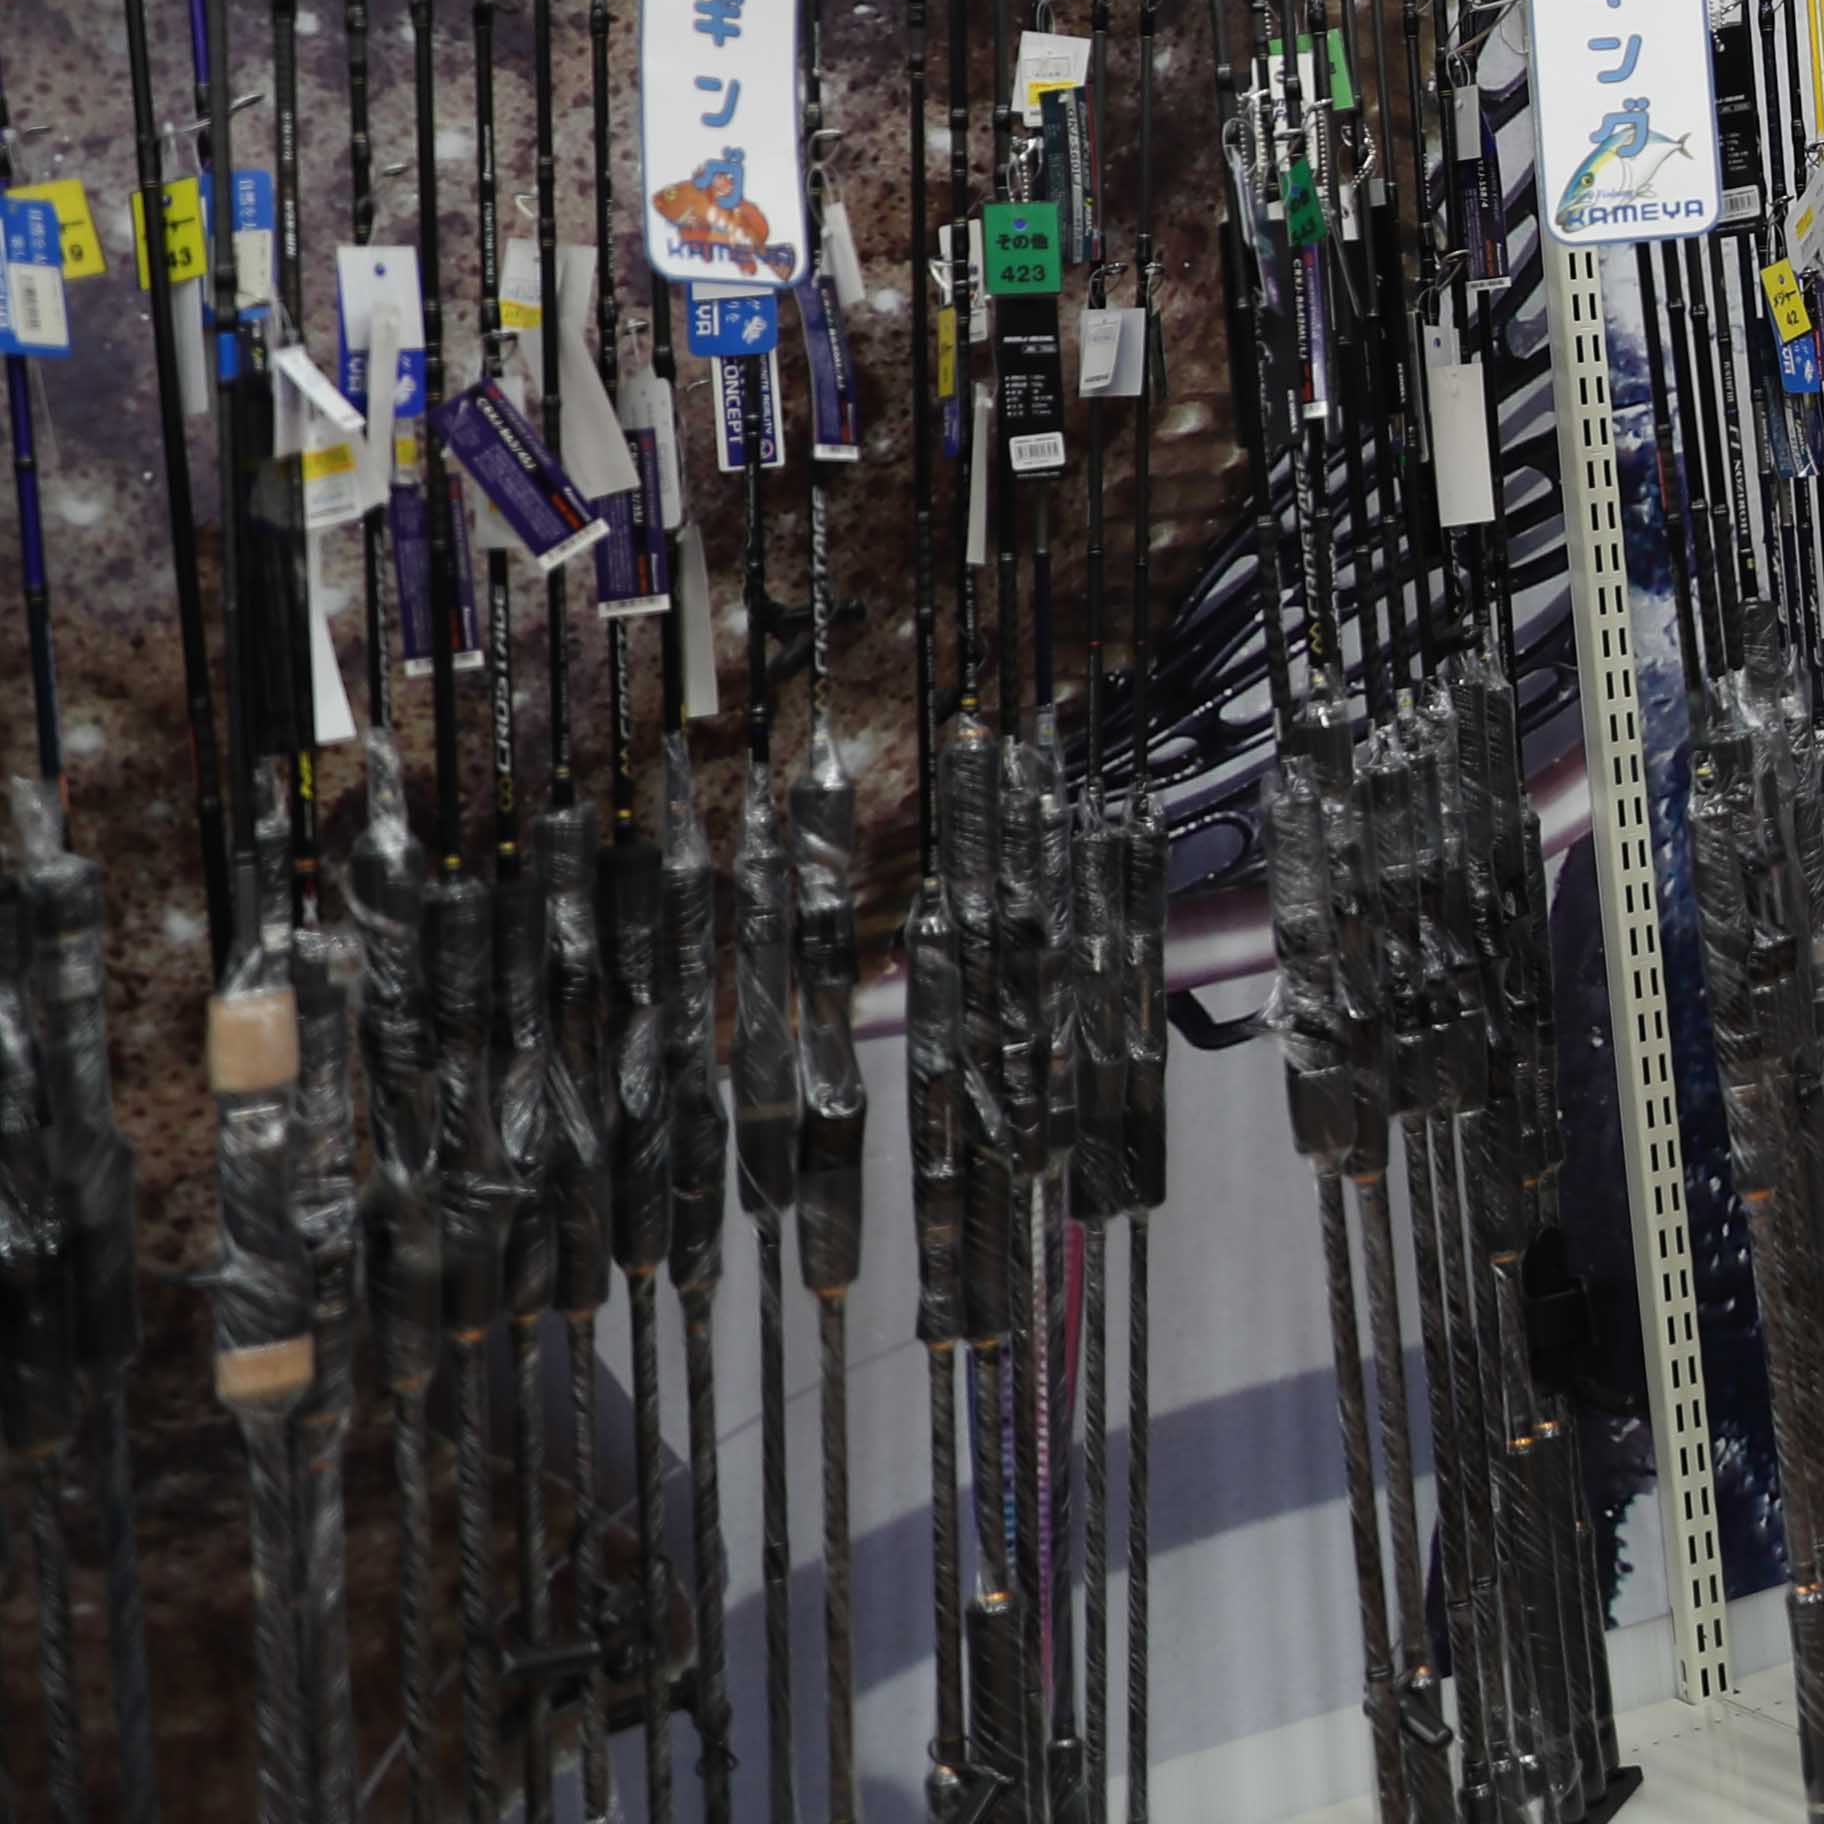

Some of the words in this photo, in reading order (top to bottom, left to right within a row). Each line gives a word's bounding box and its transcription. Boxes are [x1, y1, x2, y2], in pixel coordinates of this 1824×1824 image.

[1566, 197, 1705, 226] KAMEYA
[995, 233, 1049, 250] その他
[1001, 265, 1047, 282] 423
[1785, 311, 1800, 326] 42
[724, 359, 744, 445] ONCEPT
